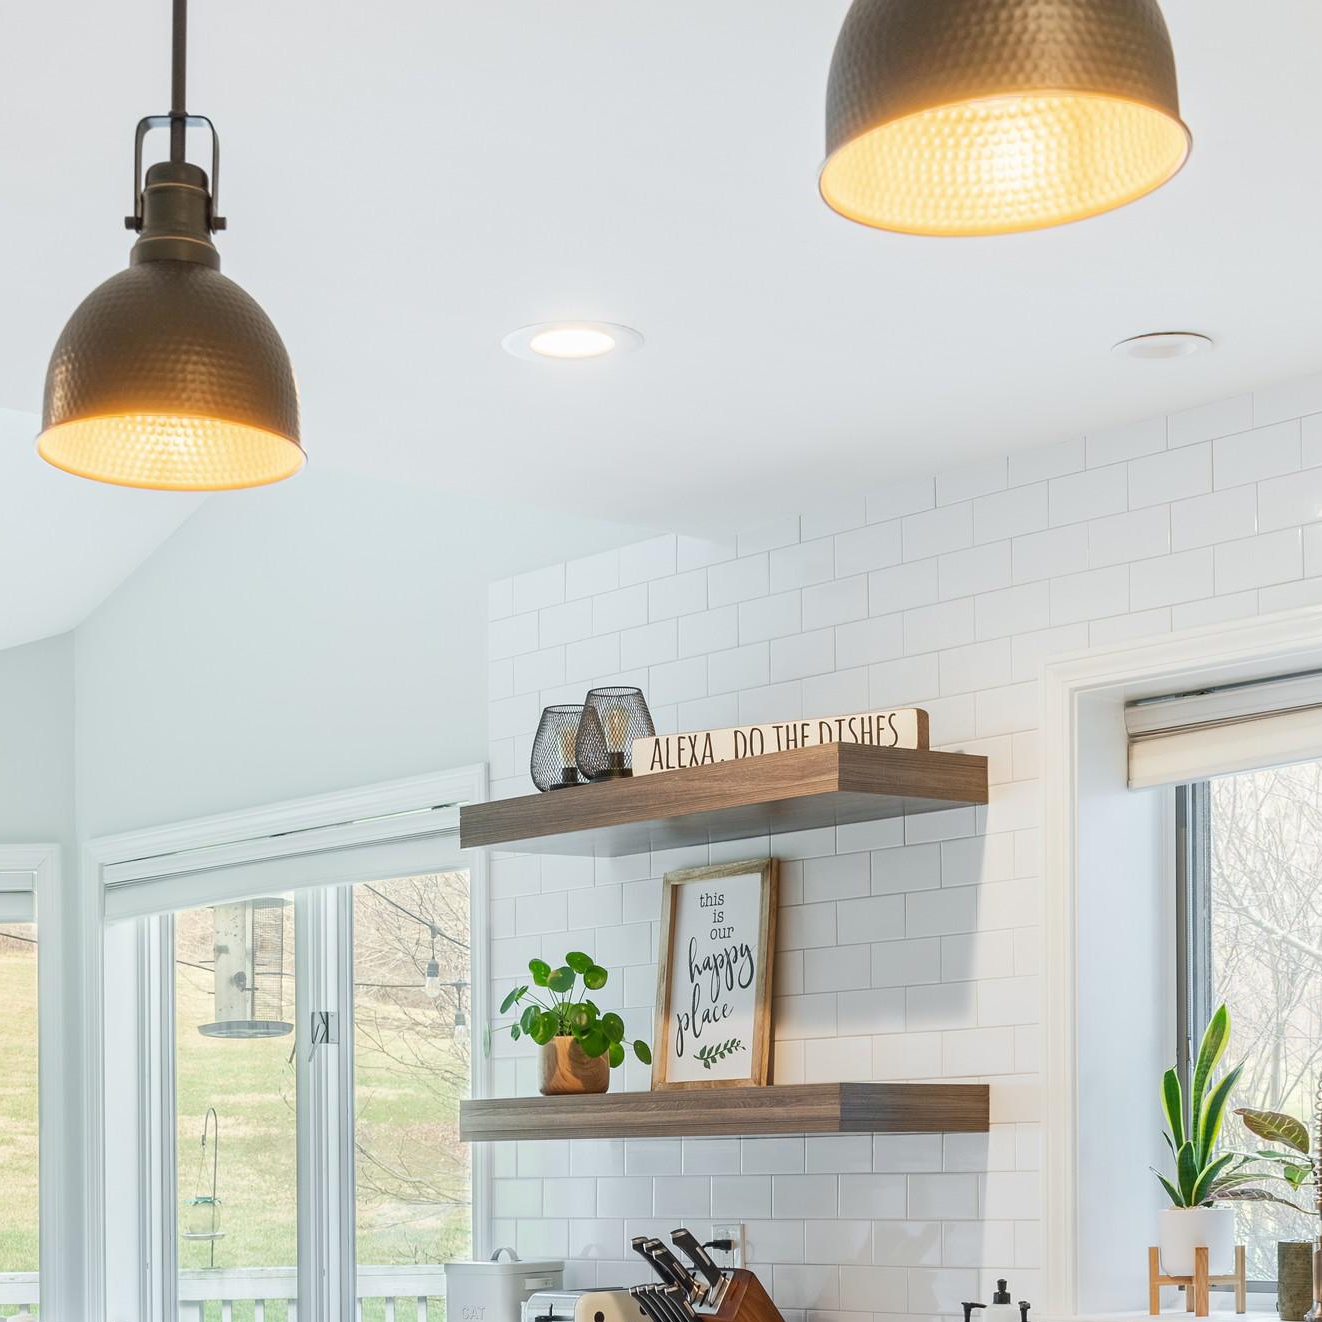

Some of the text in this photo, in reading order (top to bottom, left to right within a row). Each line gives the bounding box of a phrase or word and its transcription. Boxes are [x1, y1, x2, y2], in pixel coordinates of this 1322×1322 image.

[734, 729, 764, 760] DO
[772, 723, 810, 751] THE
[819, 713, 898, 747] DISHES
[700, 892, 725, 908] this
[712, 909, 724, 923] is
[710, 926, 734, 940] our
[689, 936, 754, 1003] happy
[676, 983, 734, 1057] place
[462, 1304, 487, 1320] CAT
